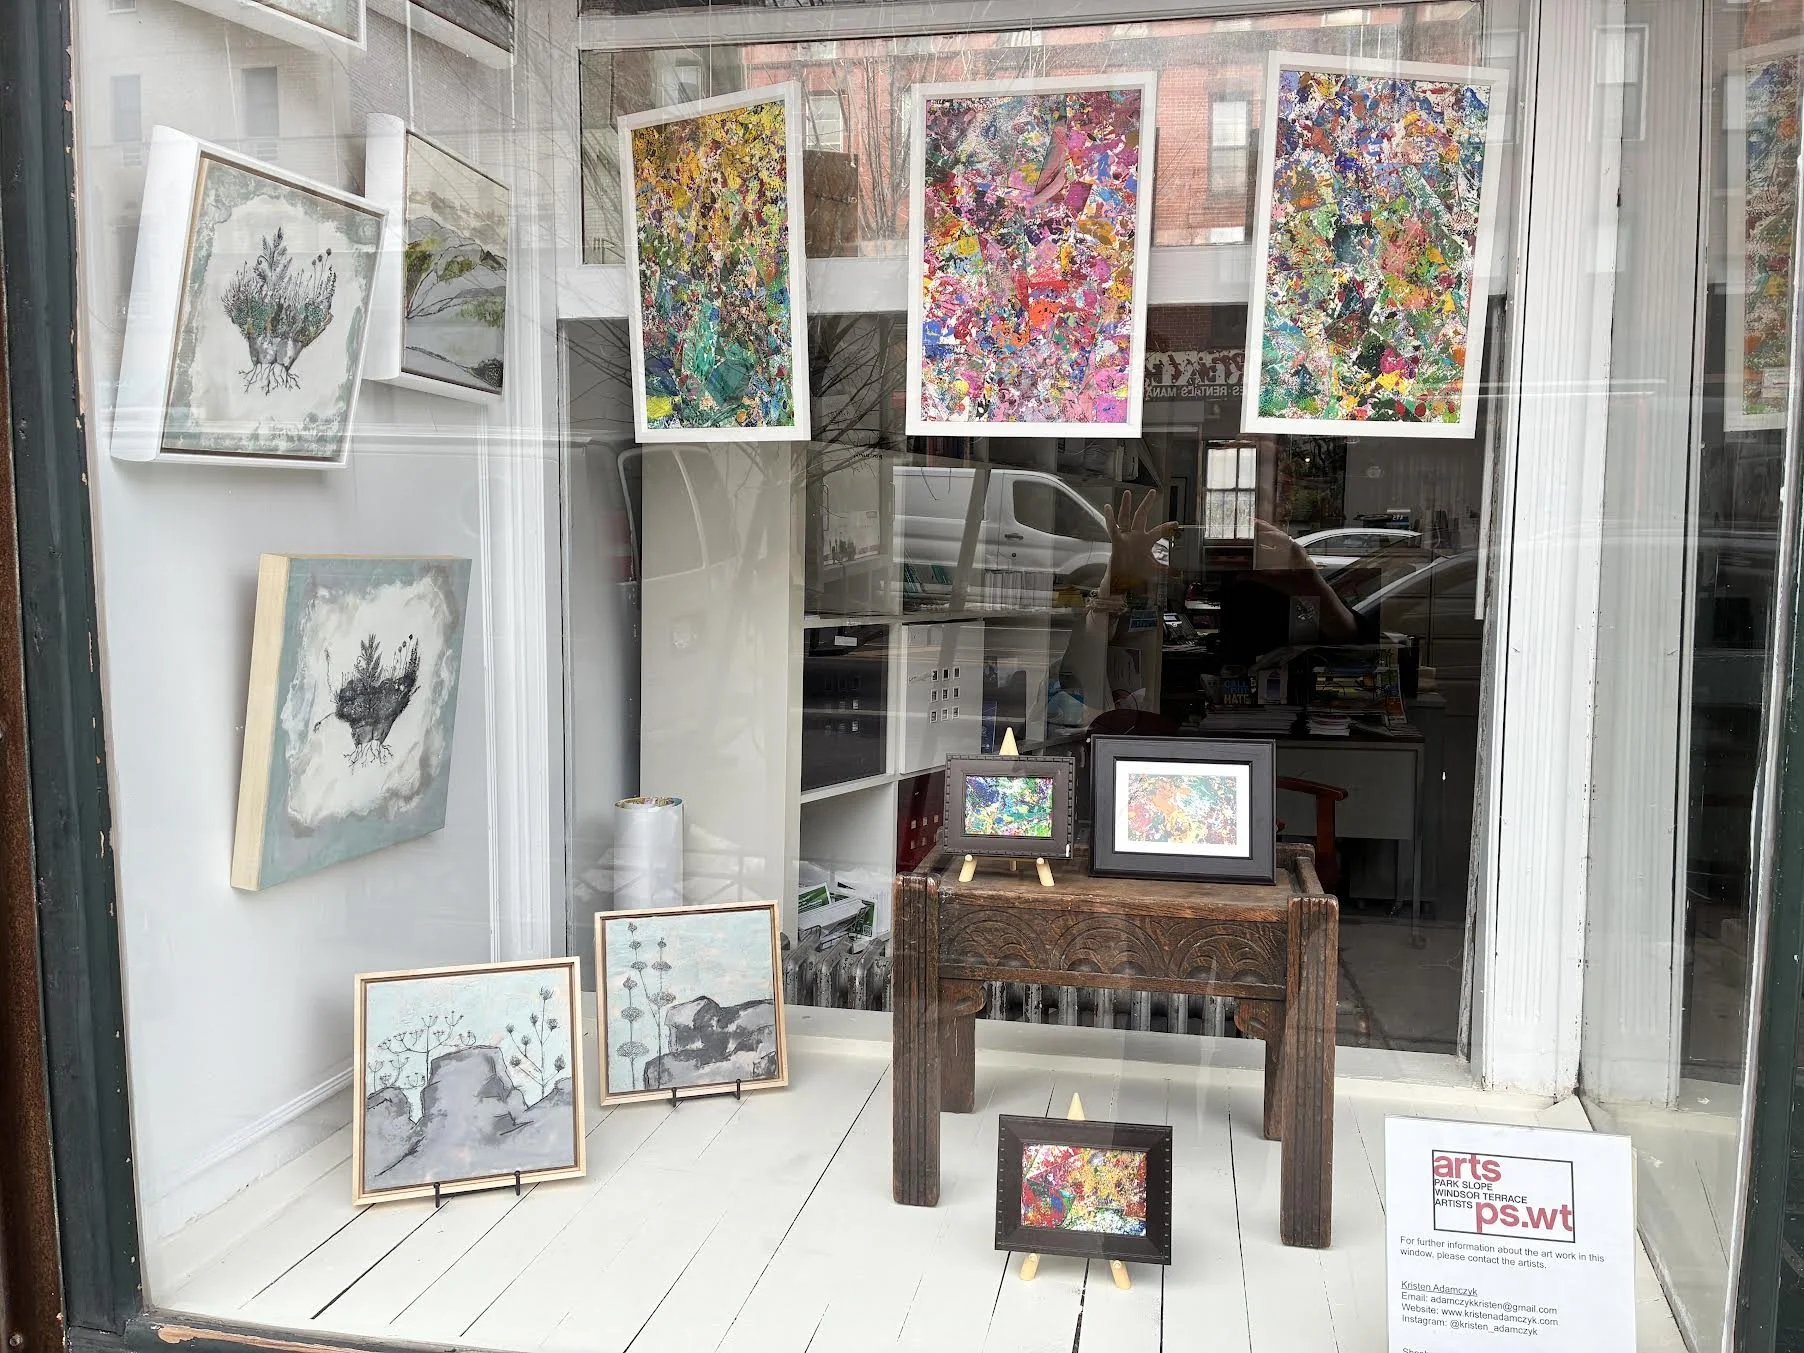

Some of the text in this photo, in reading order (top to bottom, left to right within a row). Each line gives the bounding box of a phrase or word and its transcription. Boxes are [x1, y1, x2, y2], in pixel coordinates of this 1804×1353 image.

[1434, 1154, 1502, 1183] arts
[1434, 1179, 1493, 1191] PARK SLOPE
[1435, 1188, 1528, 1204] WINDSOR TERRACE
[1434, 1198, 1473, 1209] ARTISTS
[1476, 1202, 1573, 1233] ps.wt
[1400, 1236, 1605, 1263] For further information about the art work in this
[1400, 1248, 1547, 1269] window, please contact the artists.
[1401, 1281, 1478, 1297] Kristen Adamczyk
[1401, 1291, 1557, 1314] Email: adamczykkristen@gmail.com
[1402, 1303, 1559, 1326] Website: www.kristenadamczyk.com
[1402, 1314, 1538, 1336] Instagram: @kristen_adamczyk
